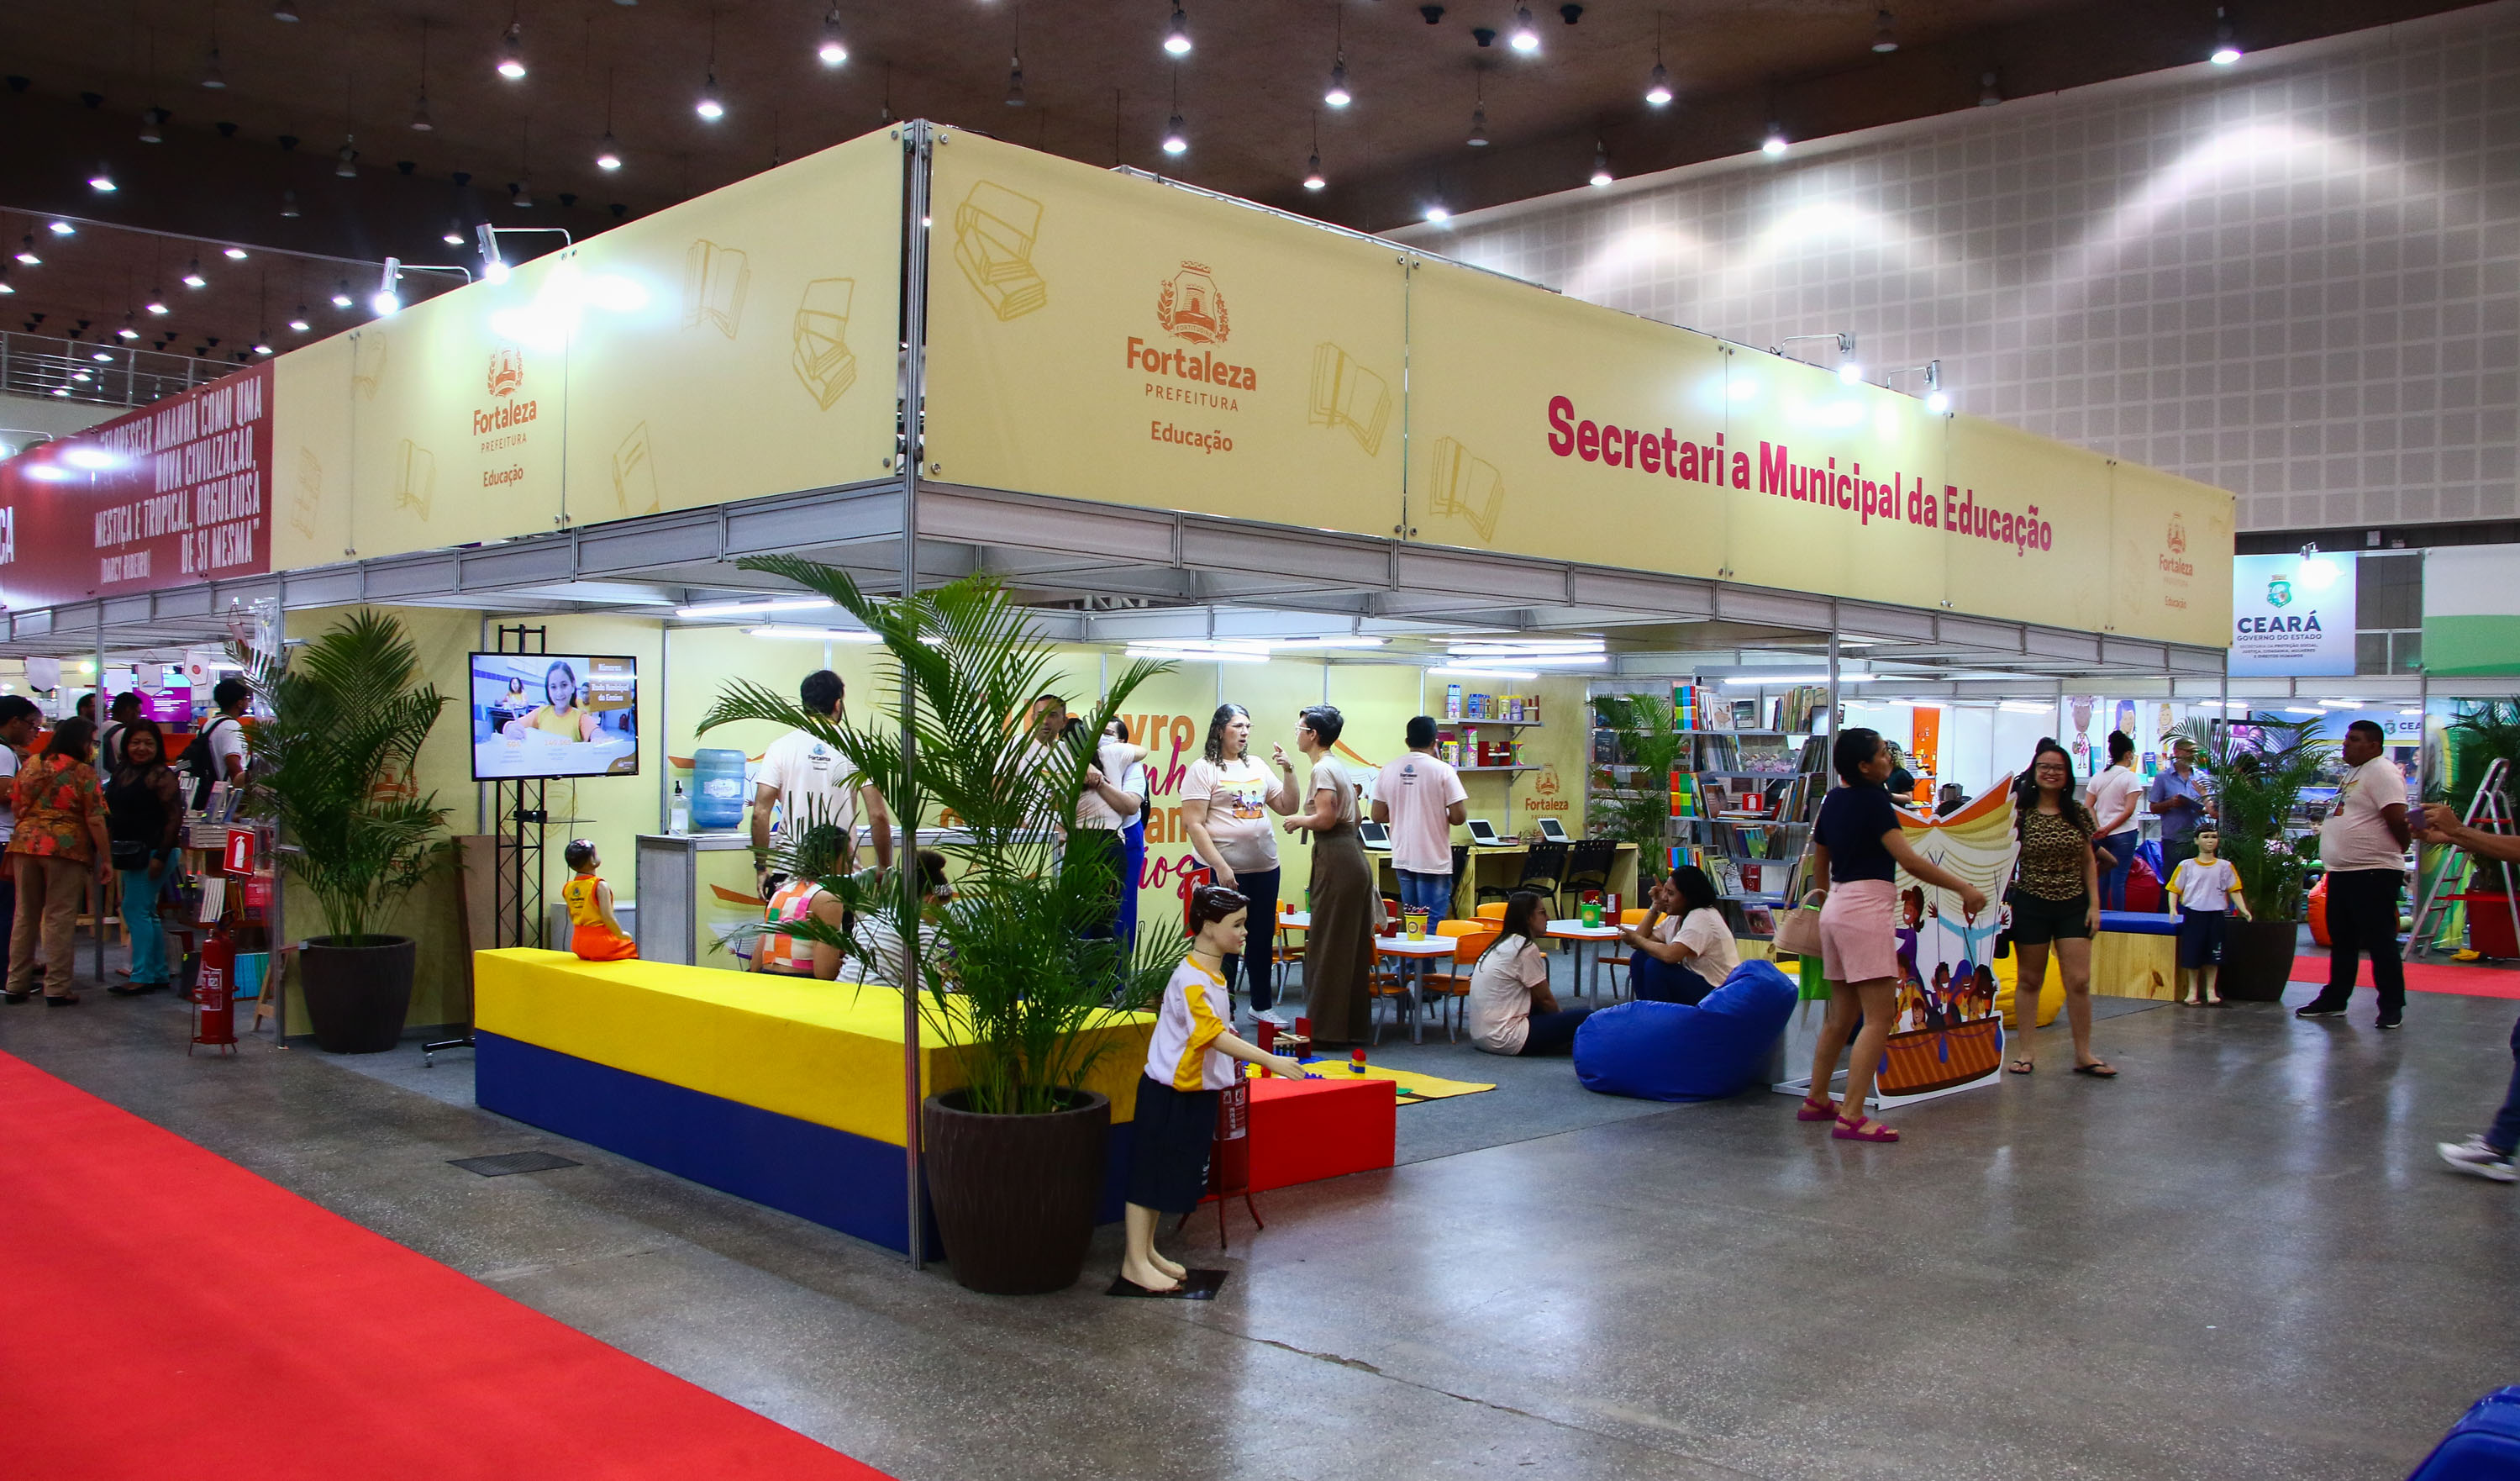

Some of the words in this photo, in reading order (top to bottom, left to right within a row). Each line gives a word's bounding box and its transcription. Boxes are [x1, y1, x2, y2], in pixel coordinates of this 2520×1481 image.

[1127, 336, 1257, 391] Fortaleza
[201, 387, 232, 436] COMO
[236, 376, 262, 424] UMA
[1145, 383, 1239, 412] PREFEITURA
[473, 399, 537, 436] Fortaleza
[481, 432, 527, 453] PREFEITURA
[1151, 420, 1234, 454] Educação
[155, 448, 182, 493] NOVA
[483, 464, 523, 488] Educação
[95, 504, 132, 551] MESTIÇA
[135, 502, 141, 540] E
[144, 490, 192, 538] TROPICAL,
[197, 471, 260, 527] ORGULHOSA
[1760, 440, 1902, 525] Municipal
[1908, 477, 1938, 528] da
[1944, 484, 2052, 557] Educação
[182, 532, 194, 574] DE
[198, 530, 208, 572] SI
[2159, 554, 2193, 577] Fortaleza
[2237, 609, 2322, 634] CEARÁ
[1525, 798, 1569, 810] Fortaleza
